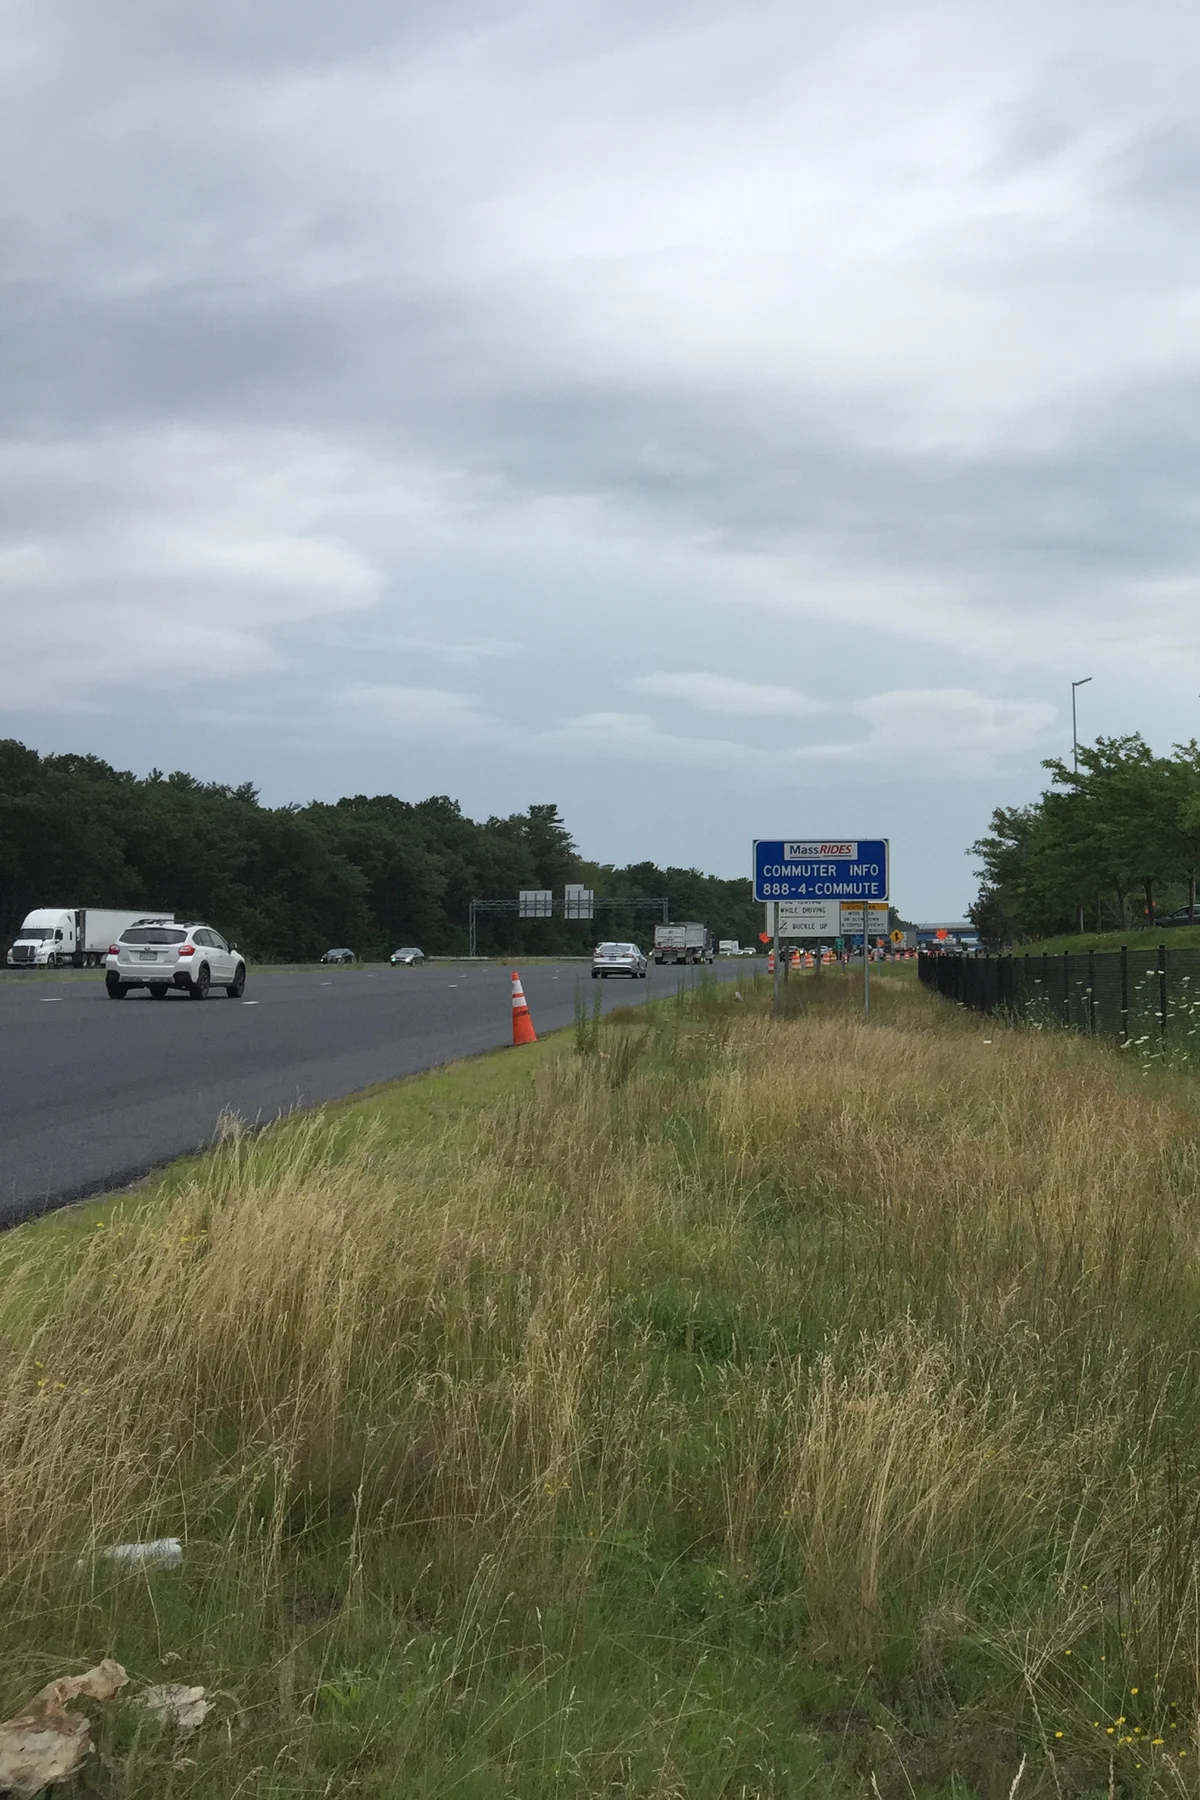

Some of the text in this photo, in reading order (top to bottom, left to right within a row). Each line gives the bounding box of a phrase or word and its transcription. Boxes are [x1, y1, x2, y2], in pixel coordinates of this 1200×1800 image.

[789, 844, 852, 855] MassRIDES
[763, 864, 879, 877] COMMUTER INFO
[763, 882, 879, 896] 888-4-COMMUTE
